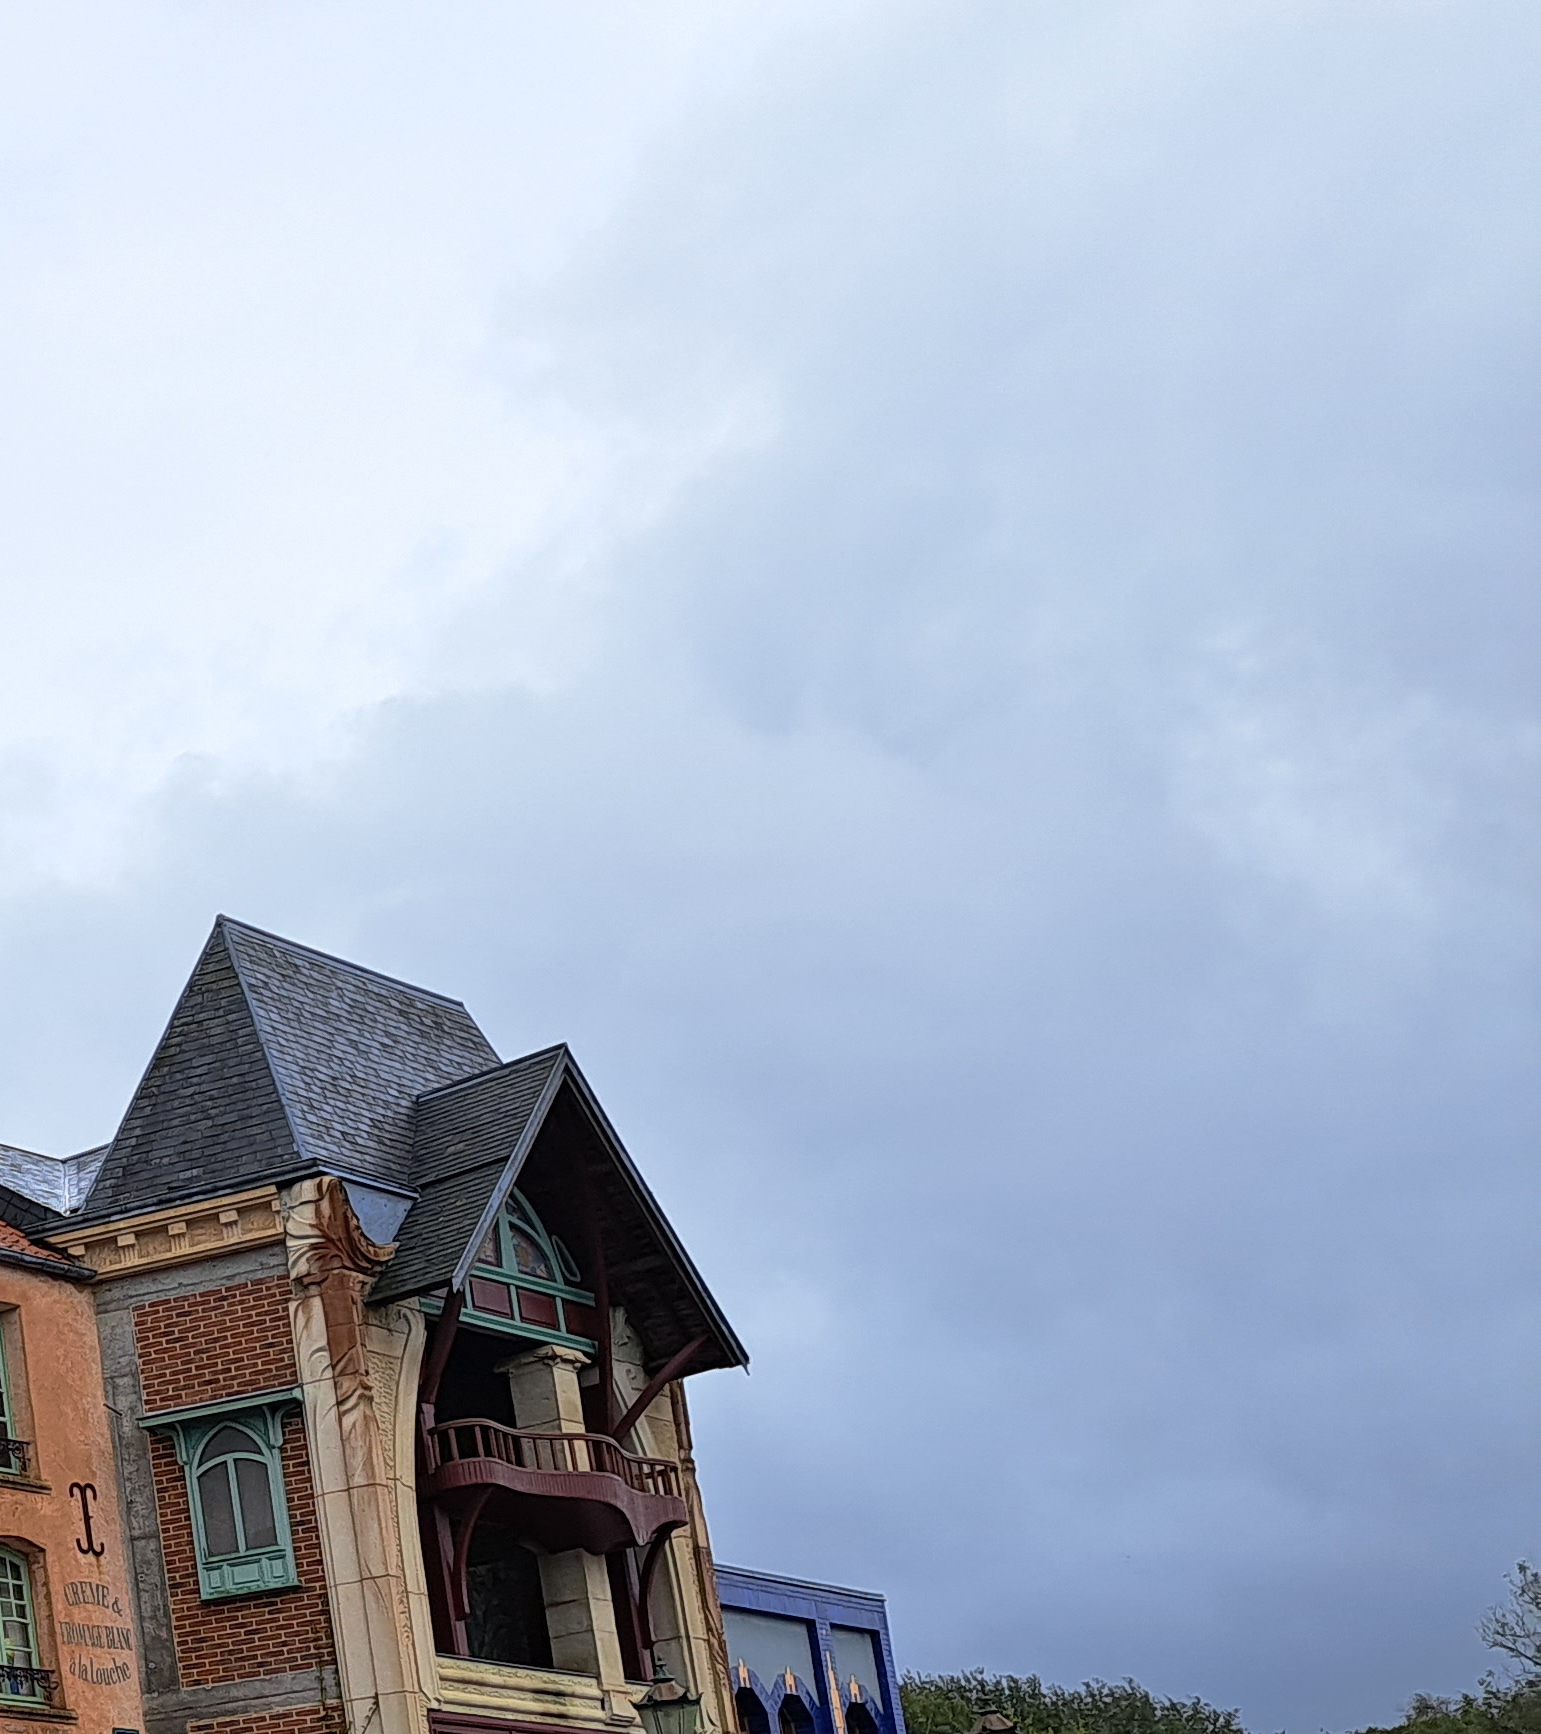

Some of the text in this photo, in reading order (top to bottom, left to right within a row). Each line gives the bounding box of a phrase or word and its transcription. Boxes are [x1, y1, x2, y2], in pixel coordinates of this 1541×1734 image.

[111, 1596, 123, 1617] &
[58, 1620, 133, 1652] FROMAGE BLANC
